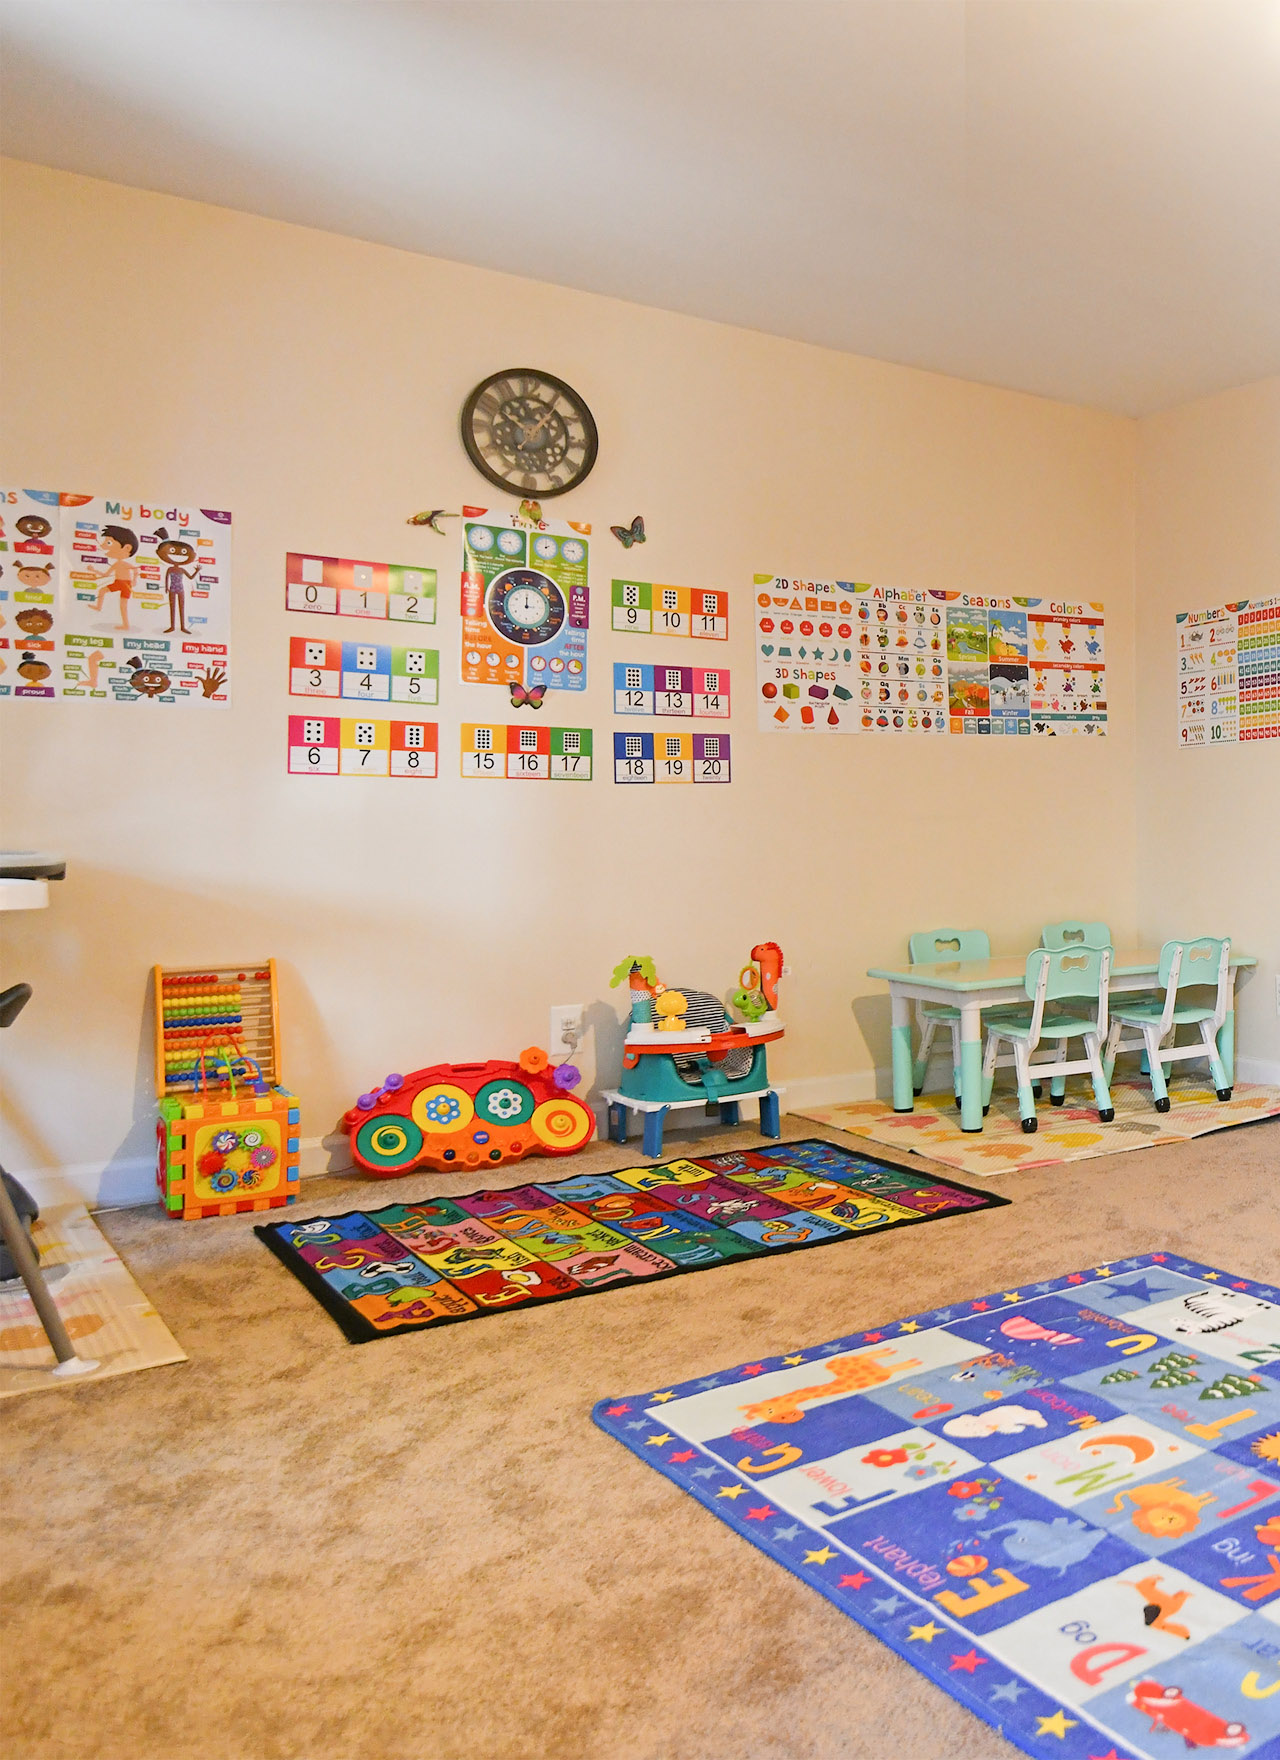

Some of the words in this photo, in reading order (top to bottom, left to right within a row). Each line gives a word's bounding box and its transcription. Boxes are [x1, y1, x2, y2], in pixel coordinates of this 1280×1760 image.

[106, 501, 132, 521] My
[140, 504, 189, 527] body
[304, 585, 318, 603] 0
[775, 578, 789, 589] 2D
[793, 580, 836, 595] Shapes
[874, 587, 928, 602] Alphabet
[303, 603, 323, 611] zero
[360, 591, 368, 609] 1
[406, 596, 419, 614] 2
[963, 594, 1011, 609] Seasons
[626, 607, 638, 624] 9
[1050, 602, 1083, 615] Colors
[1188, 608, 1225, 624] Numbers
[662, 612, 681, 628] 10
[701, 616, 716, 632] 11
[73, 637, 88, 646] my
[90, 638, 104, 646] leg
[1210, 628, 1216, 643] 2
[127, 641, 142, 649] my
[143, 641, 165, 649] head
[186, 645, 200, 653] my
[201, 645, 224, 653] hand
[309, 669, 322, 687] 3
[359, 673, 373, 691] 4
[775, 667, 789, 680] 3D
[793, 668, 836, 682] Shapes
[408, 677, 421, 694] 5
[625, 690, 644, 707] 12
[664, 692, 683, 708] 13
[702, 695, 720, 710] 14
[1211, 724, 1221, 740] 10
[308, 747, 321, 765] 6
[359, 749, 371, 766] 7
[407, 751, 420, 769] 8
[473, 753, 495, 770] 15
[518, 754, 538, 770] 16
[561, 756, 581, 772] 17
[625, 760, 644, 776] 18
[664, 759, 683, 775] 19
[702, 759, 721, 776] 20
